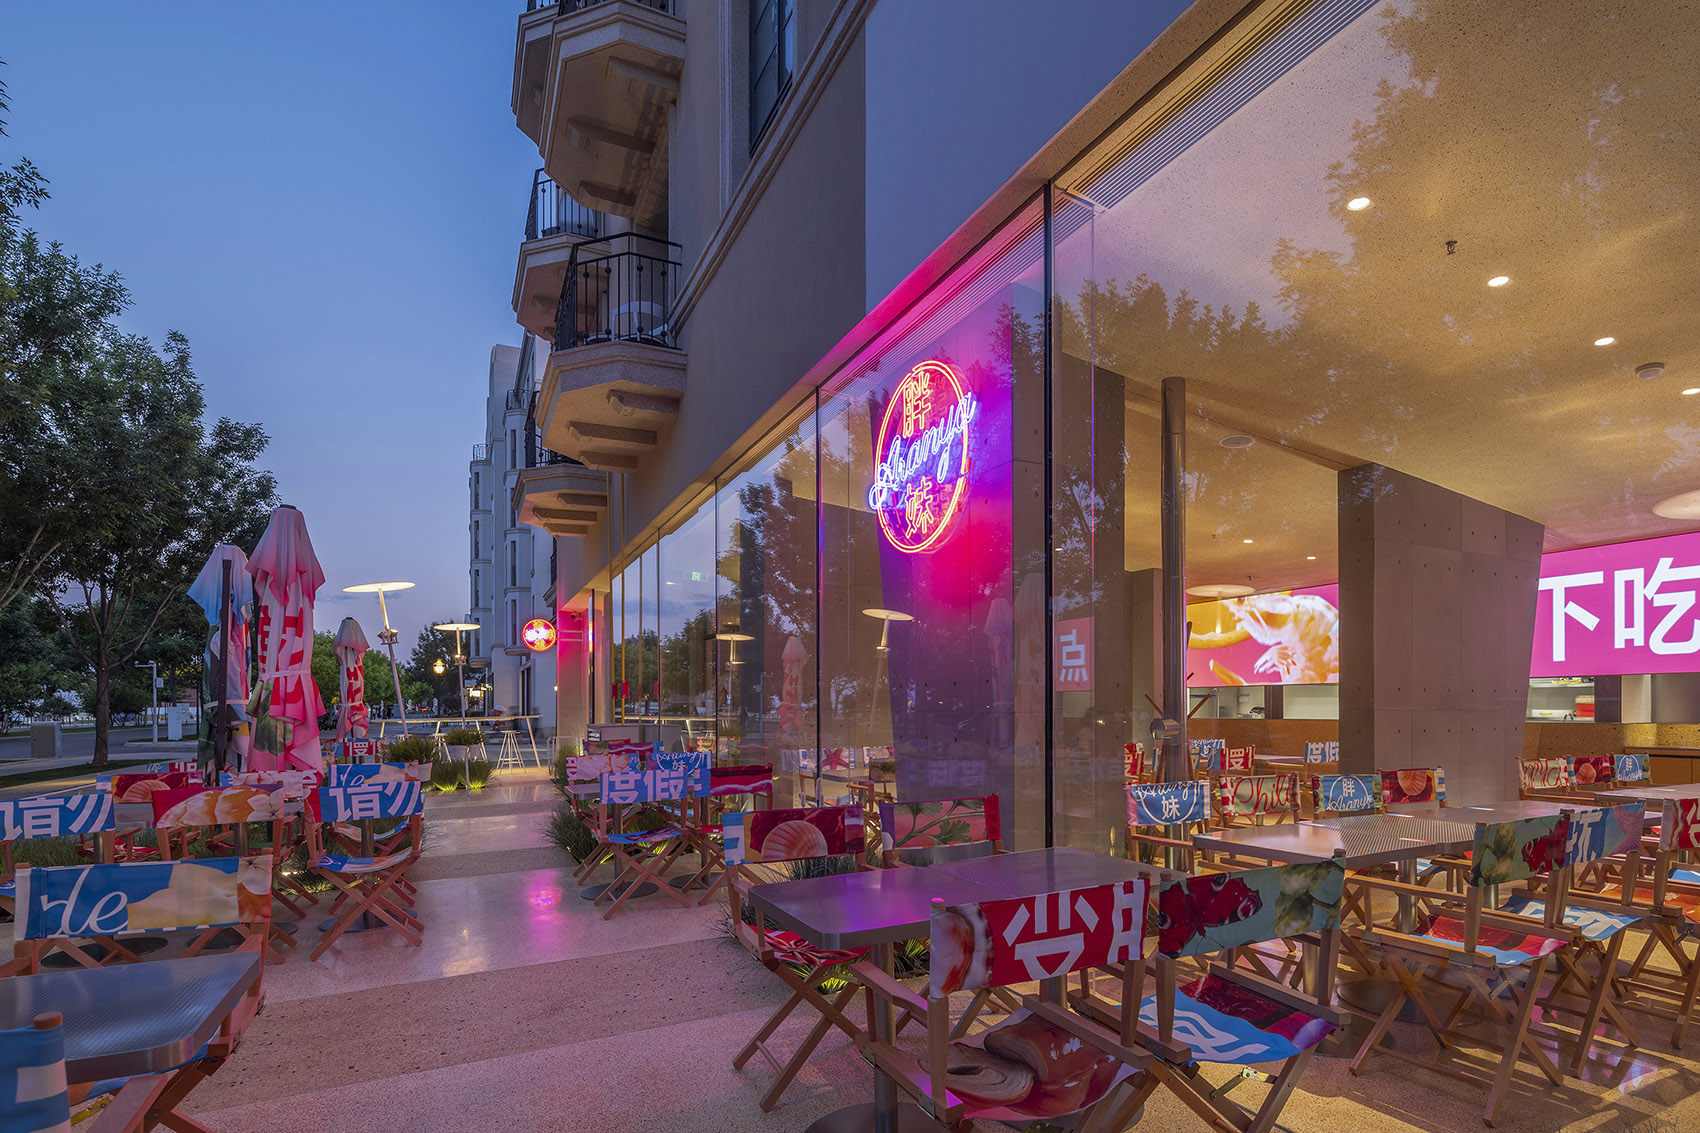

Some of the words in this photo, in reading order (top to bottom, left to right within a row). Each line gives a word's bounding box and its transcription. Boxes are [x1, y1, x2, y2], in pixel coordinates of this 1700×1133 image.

[902, 371, 932, 439] 胖
[868, 391, 976, 510] Aranya
[1059, 628, 1089, 682] 点
[1161, 796, 1180, 820] 妹
[1342, 778, 1356, 797] 胖
